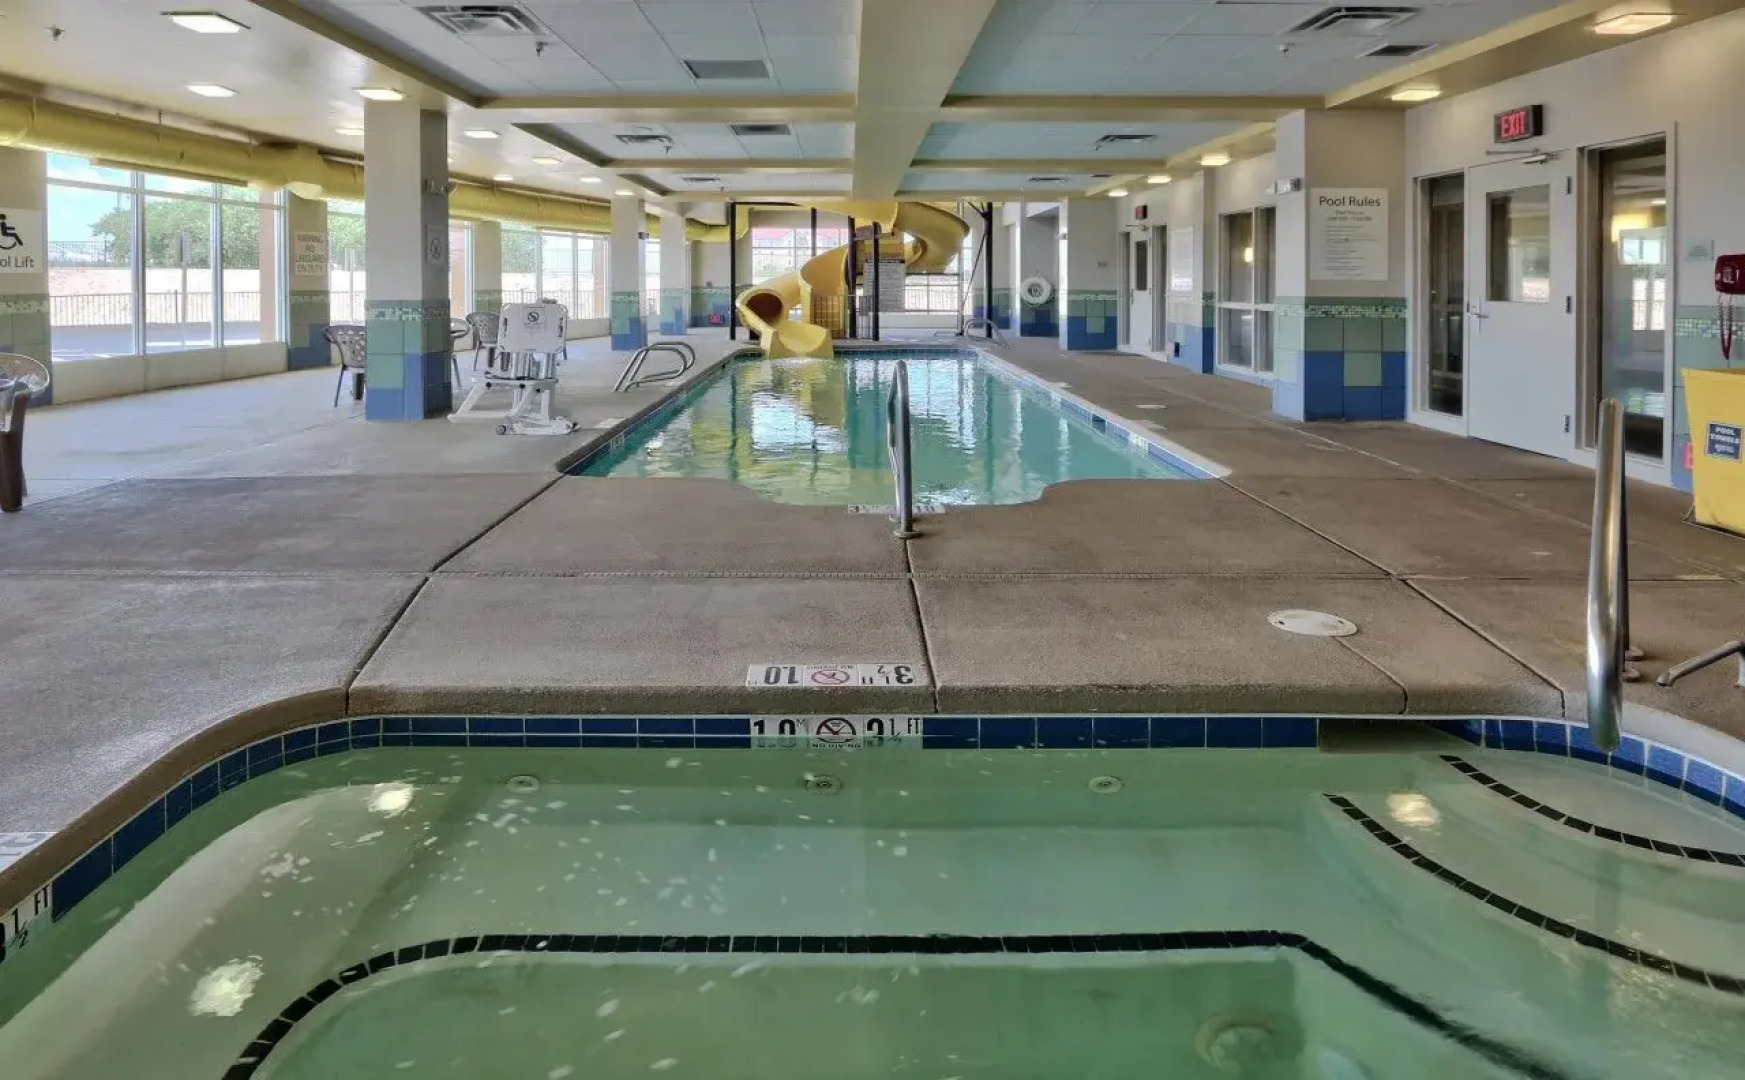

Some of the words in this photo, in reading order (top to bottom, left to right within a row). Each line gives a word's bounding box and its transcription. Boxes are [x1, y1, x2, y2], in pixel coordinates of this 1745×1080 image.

[1500, 112, 1526, 138] EXIT
[1319, 195, 1345, 206] Pool
[1349, 195, 1382, 206] Rules
[14, 255, 34, 267] Lift
[1715, 426, 1736, 435] POOL
[907, 717, 920, 735] FT
[34, 883, 50, 916] FT
